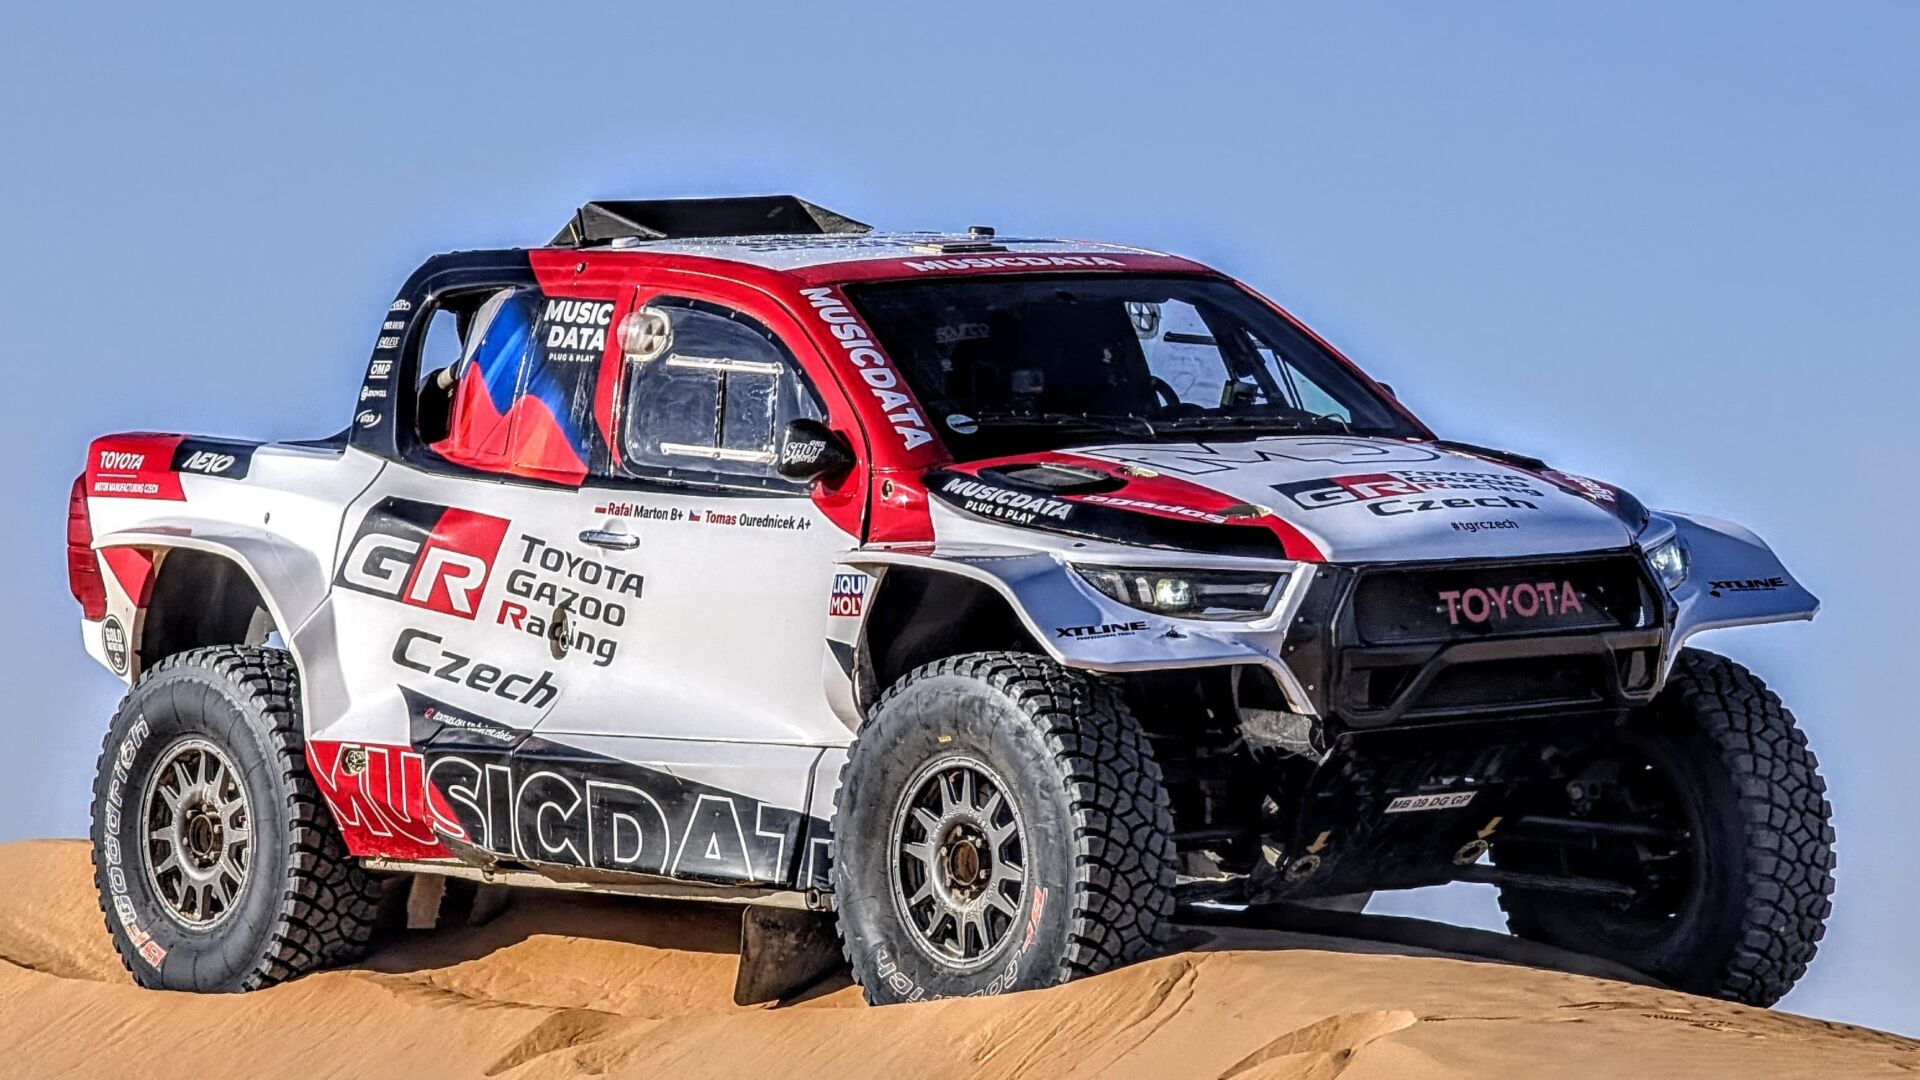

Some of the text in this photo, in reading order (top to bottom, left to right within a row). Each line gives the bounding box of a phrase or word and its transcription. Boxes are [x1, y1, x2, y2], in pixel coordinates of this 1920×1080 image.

[903, 255, 1126, 272] MUSICDATA
[543, 299, 615, 326] MUSIC
[546, 325, 605, 352] DATA
[548, 353, 568, 361] PLUG
[575, 354, 595, 363] PLAY
[370, 363, 391, 375] OMP
[800, 287, 933, 451] MUSICDATA
[100, 451, 145, 470] TOYOTA
[782, 441, 823, 464] SHOT
[1387, 470, 1529, 482] TOYOTA
[1405, 476, 1531, 488] GAZOO
[942, 478, 1073, 520] MUSICDATA
[1293, 480, 1418, 508] GR
[1416, 482, 1545, 497] Racing
[964, 500, 1036, 524] PLUG & PLAY
[1367, 496, 1538, 516] Czech
[607, 502, 811, 531] Rafal Marton B+ Tomas Ourednicek A+
[1451, 518, 1519, 533] #tgrczech
[344, 533, 487, 614] GR
[519, 534, 644, 598] TOYOTA
[832, 575, 866, 595] LIQUI
[1707, 577, 1788, 590] XTLINE
[505, 569, 626, 627] GAZOO
[830, 596, 862, 615] MOLY
[1439, 580, 1583, 625] TOYOTA
[1055, 621, 1151, 638] XTLINE
[392, 627, 559, 709] Czech
[1389, 794, 1471, 810] MB 09 DG GP
